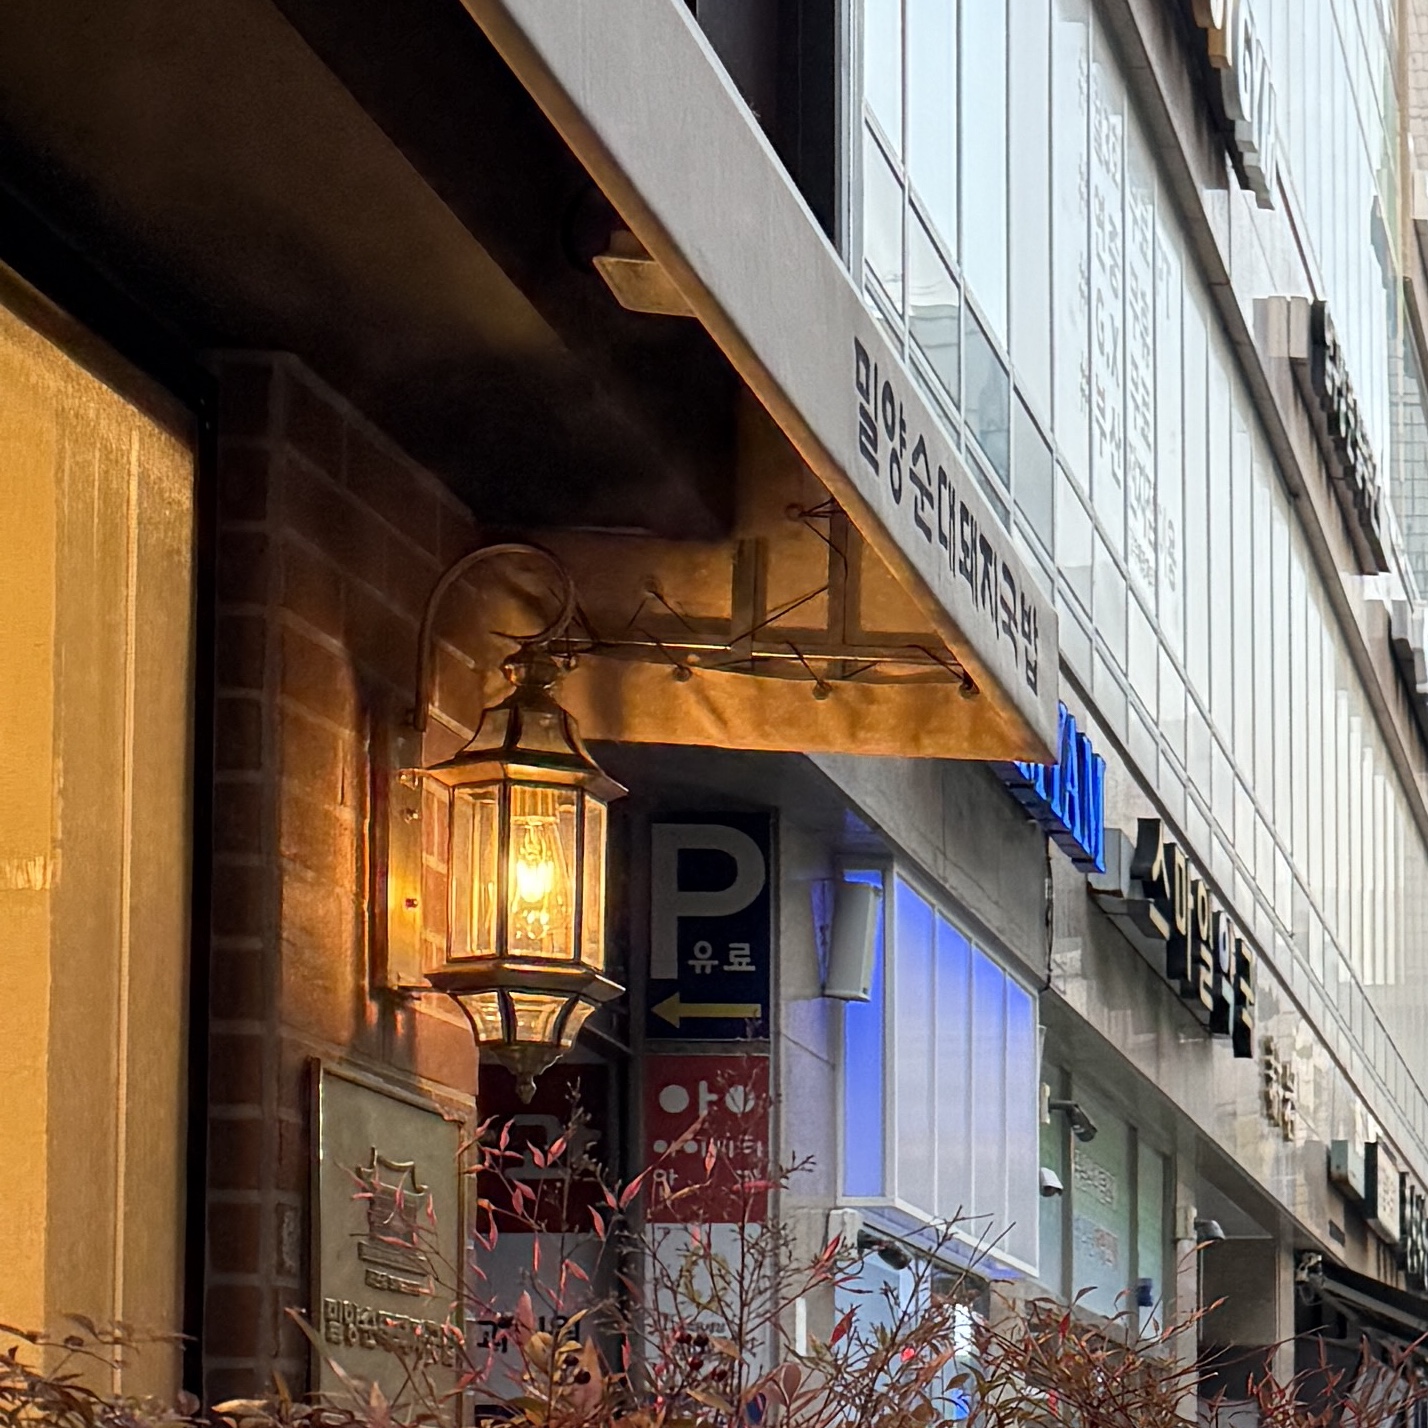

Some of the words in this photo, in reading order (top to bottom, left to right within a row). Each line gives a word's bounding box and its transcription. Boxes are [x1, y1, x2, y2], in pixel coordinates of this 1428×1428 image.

[853, 336, 1040, 698] 밀양순대돼지국밥
[650, 823, 767, 980] P
[686, 940, 758, 974] 유료
